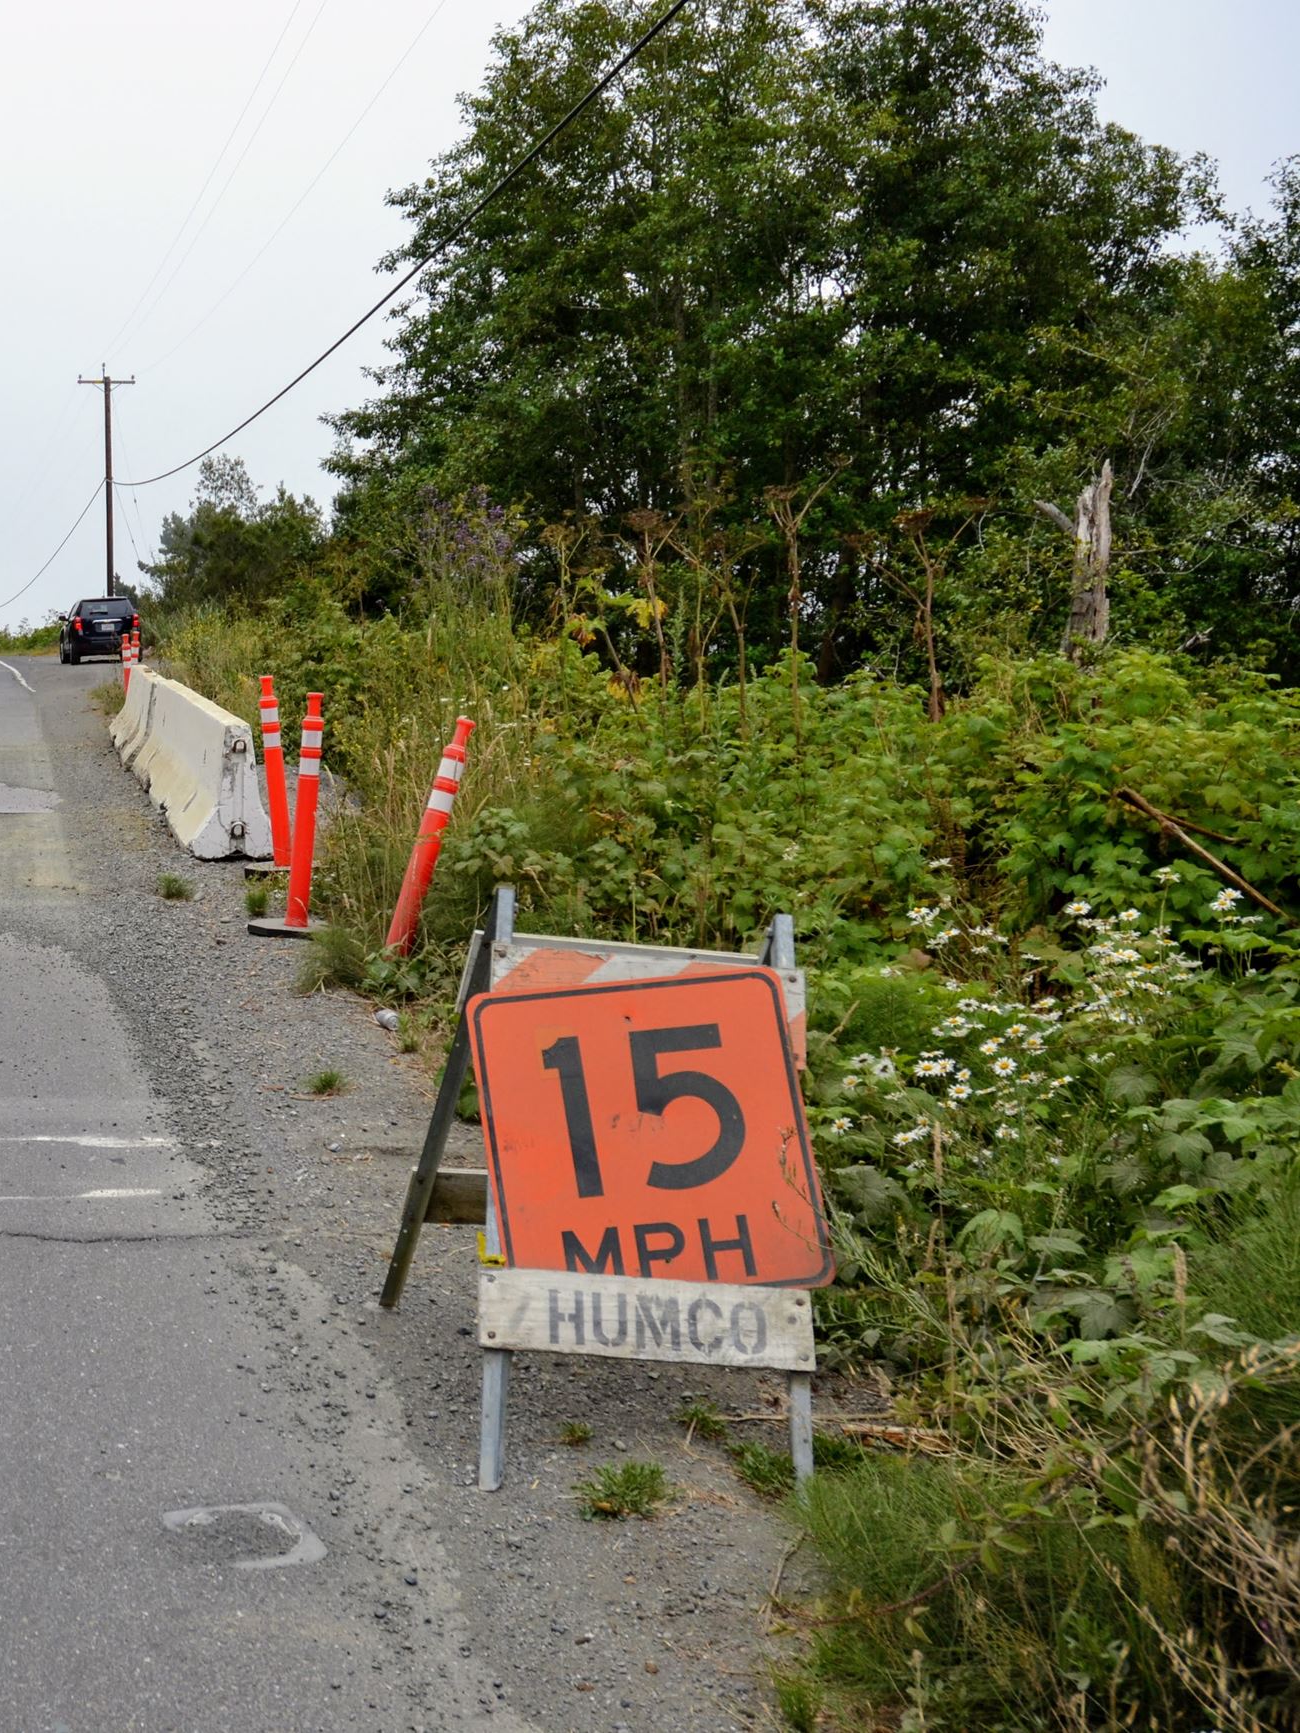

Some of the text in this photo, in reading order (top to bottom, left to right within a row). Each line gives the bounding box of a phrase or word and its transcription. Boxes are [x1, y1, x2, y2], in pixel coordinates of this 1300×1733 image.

[542, 1023, 746, 1198] 15
[561, 1214, 756, 1280] MPH
[549, 1290, 767, 1355] HUMCO
